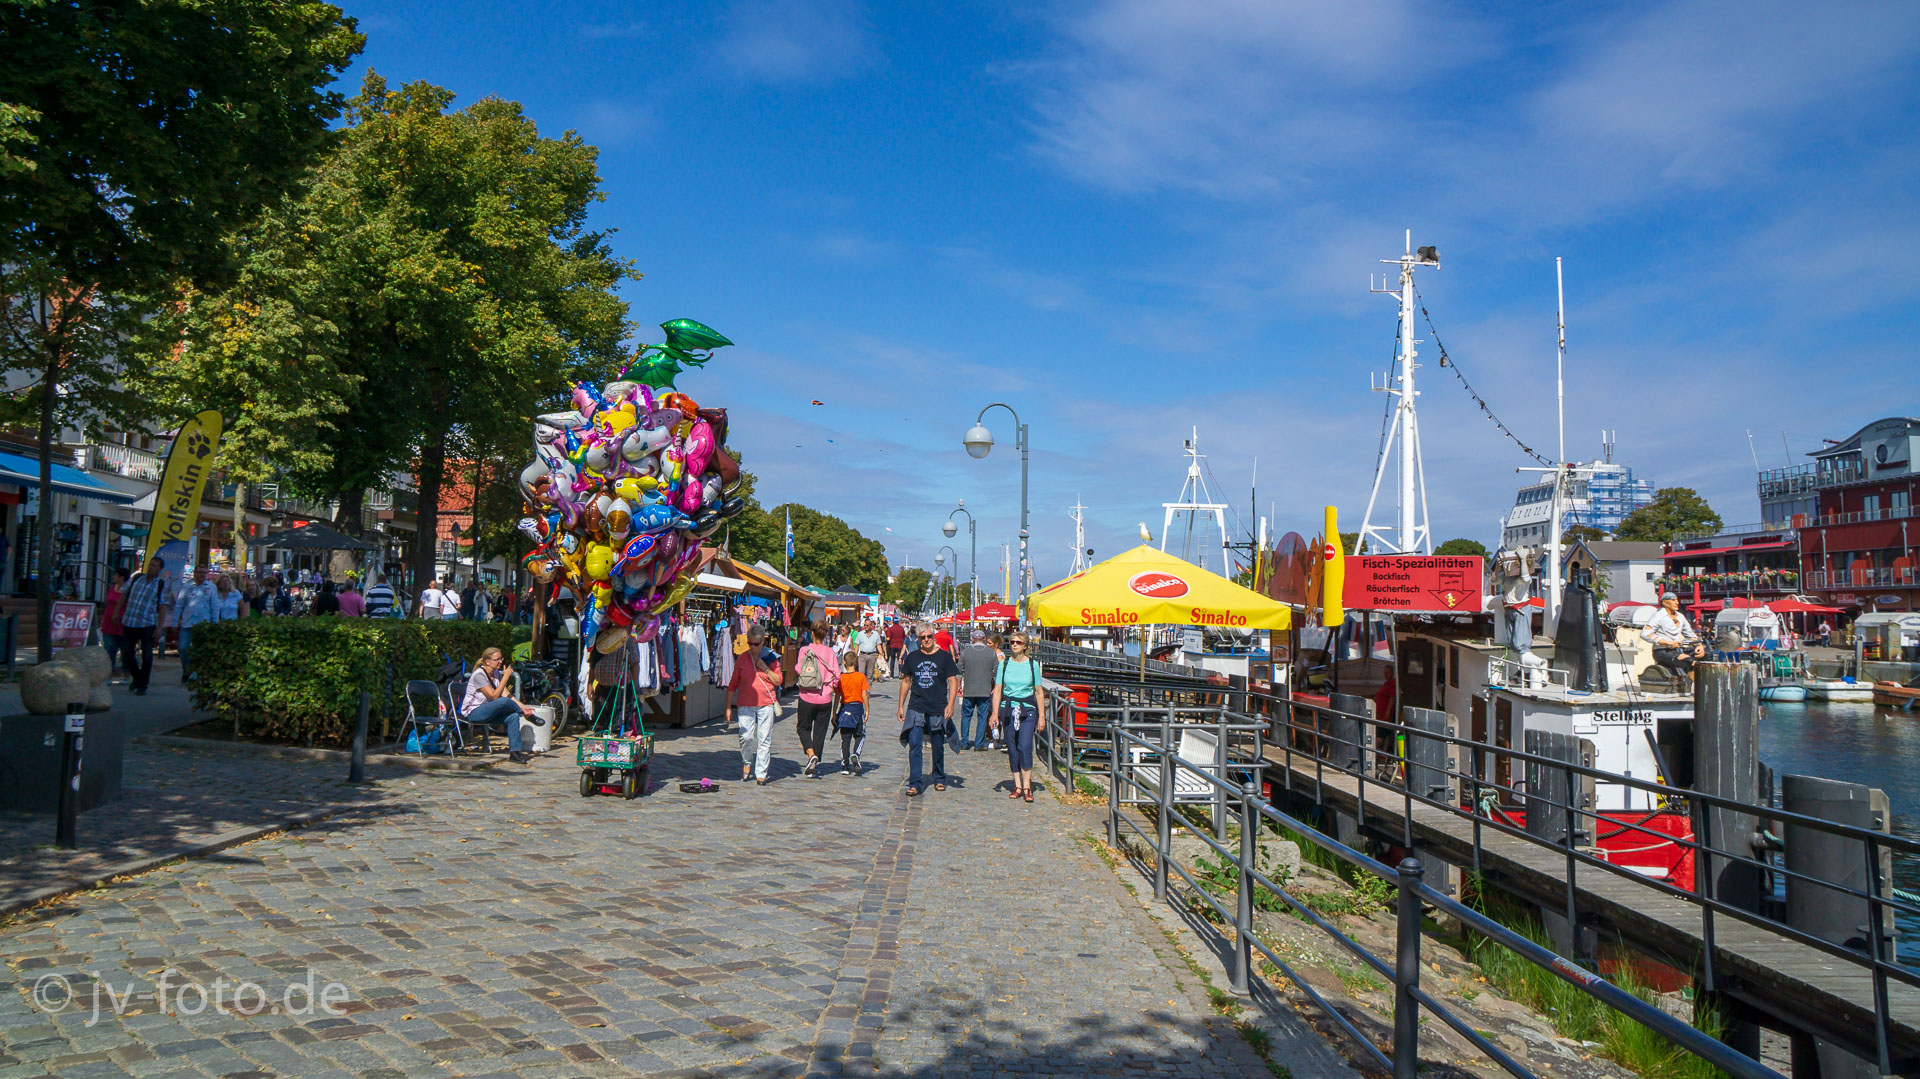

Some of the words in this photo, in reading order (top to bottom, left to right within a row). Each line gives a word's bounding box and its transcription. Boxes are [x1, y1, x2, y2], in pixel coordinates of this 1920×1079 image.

[1362, 557, 1474, 571] Fisch-Spezialitäten
[1373, 572, 1411, 581] Backfisch
[1135, 577, 1182, 594] Sinalco
[1366, 584, 1420, 593] Räucherfisch
[1373, 597, 1411, 606] Brötchen
[53, 613, 89, 630] Sale
[1081, 607, 1139, 625] Sinalco
[1190, 607, 1247, 626] Sinalco
